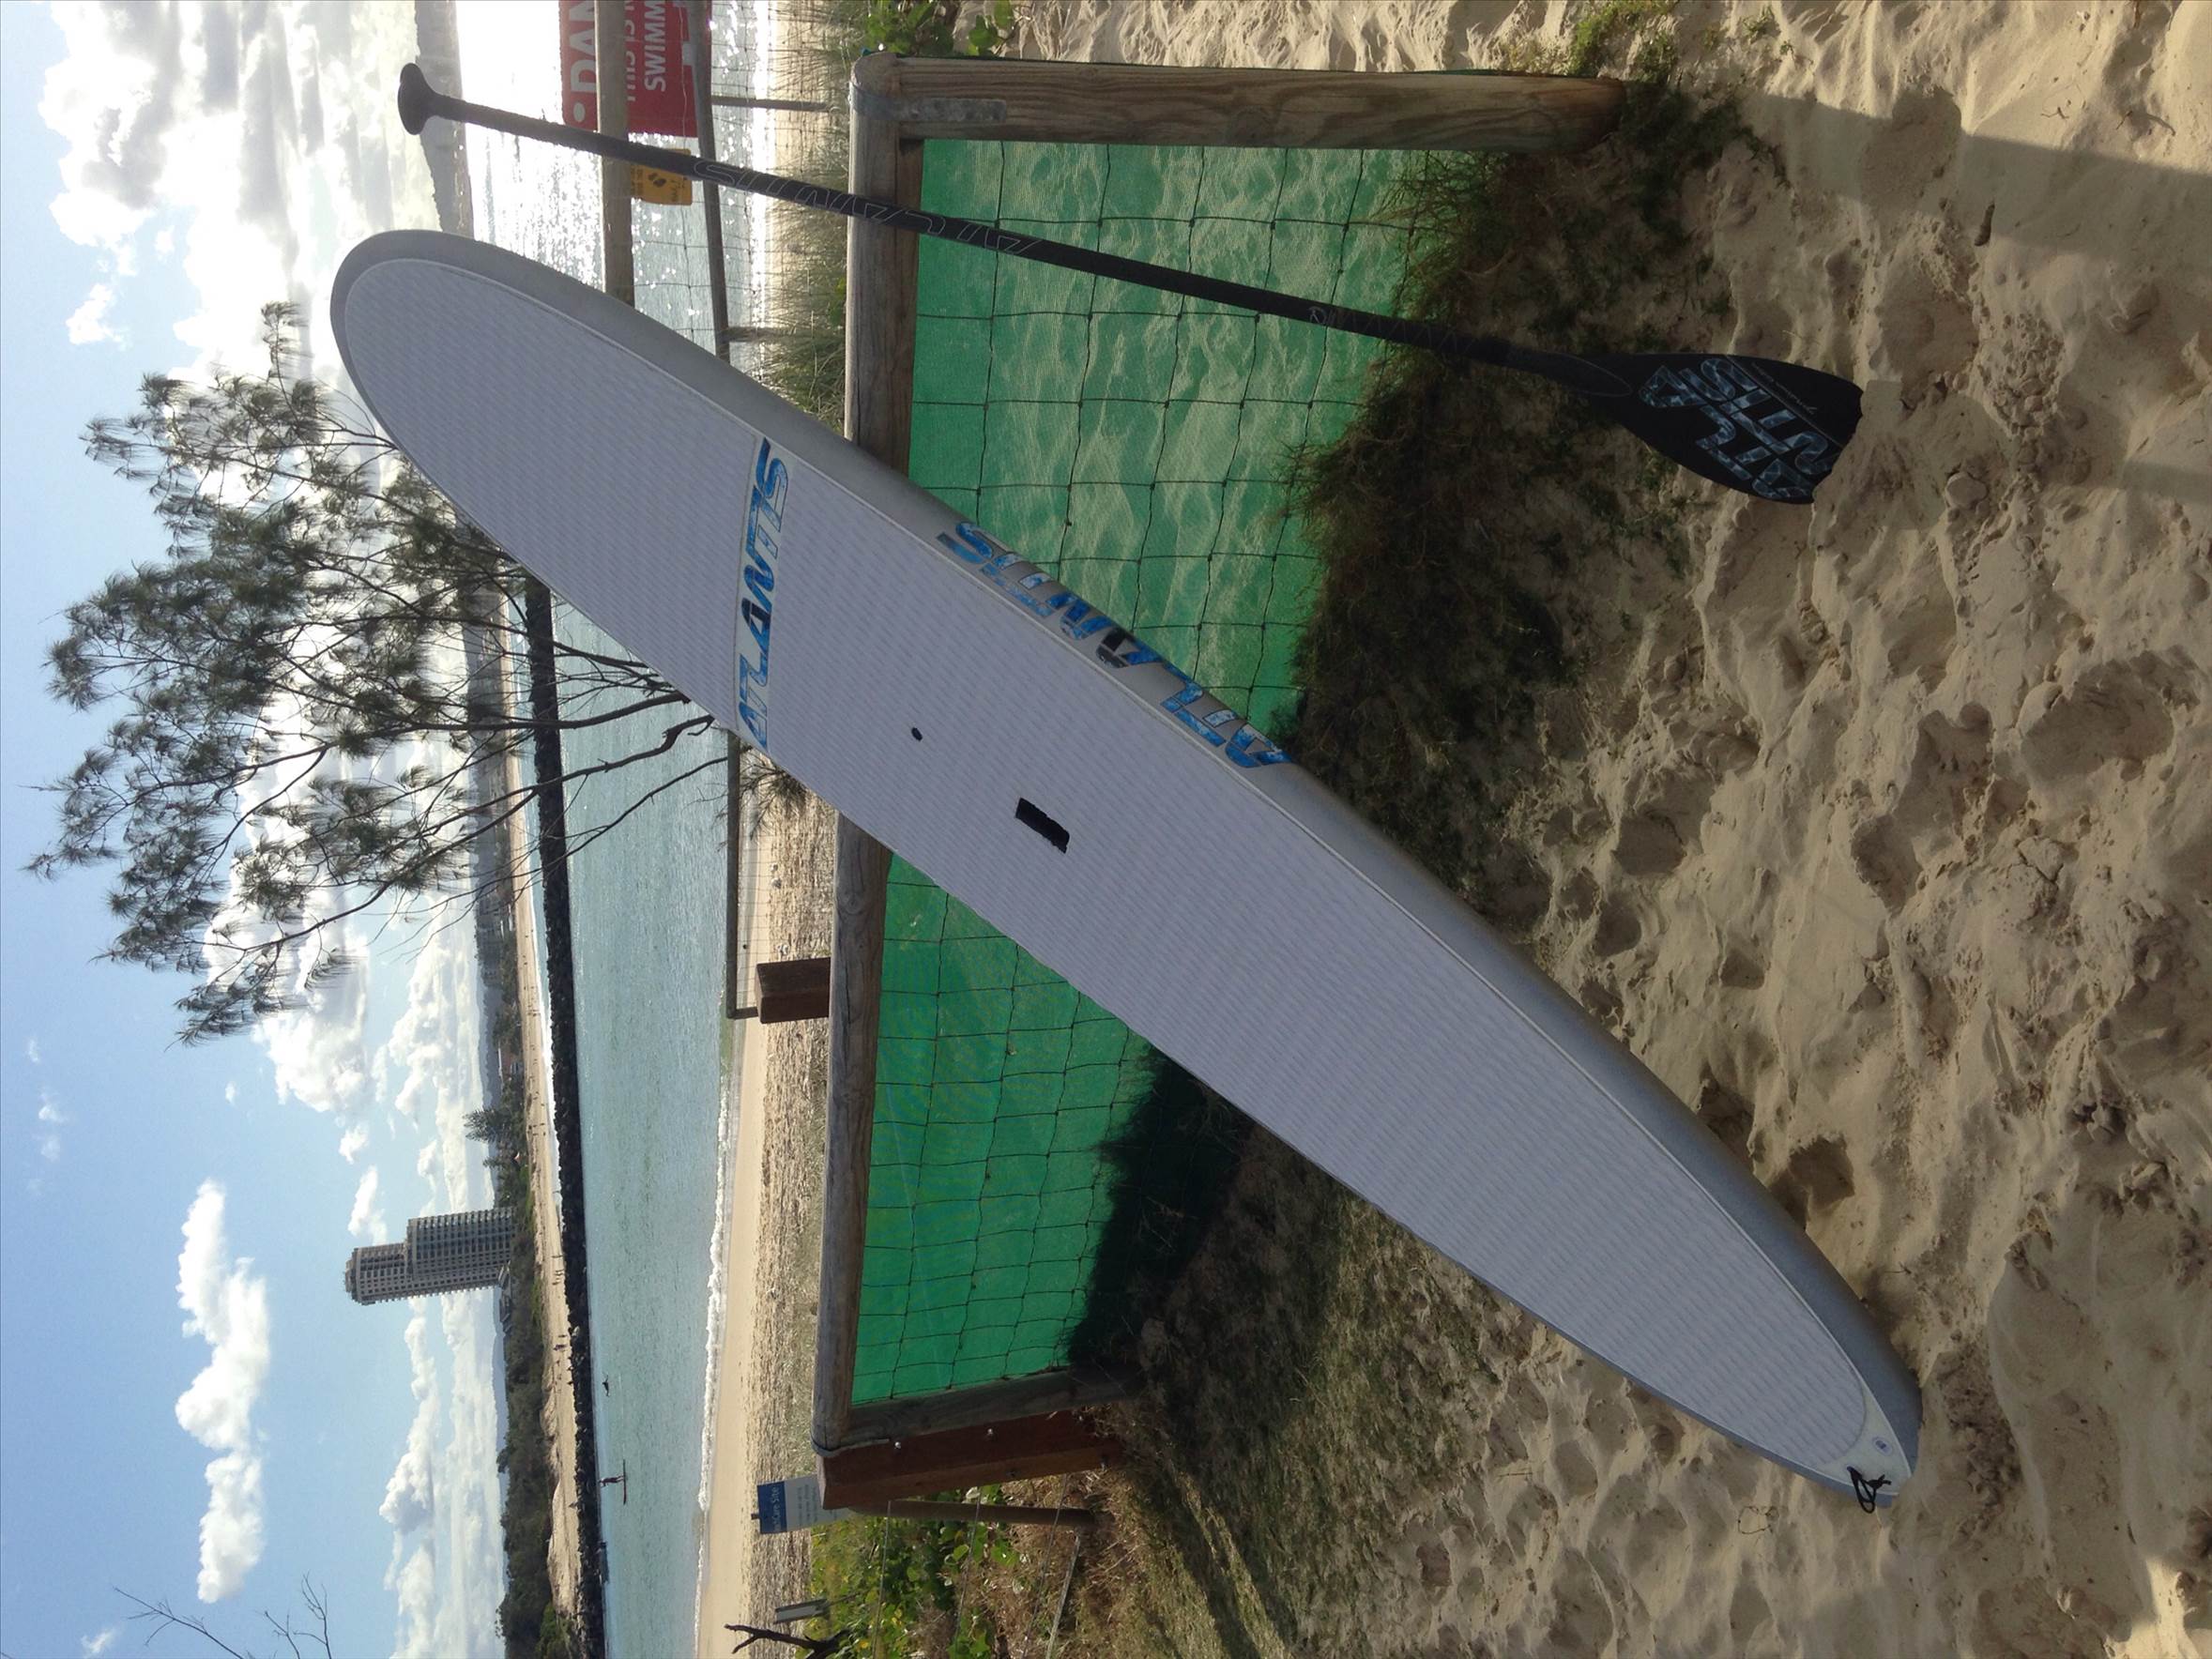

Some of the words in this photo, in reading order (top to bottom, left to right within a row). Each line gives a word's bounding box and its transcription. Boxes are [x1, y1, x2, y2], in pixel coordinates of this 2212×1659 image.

[644, 0, 666, 92] SWIMM
[738, 435, 789, 750] ATLANTIS
[936, 521, 1292, 769] ATLANTIS
